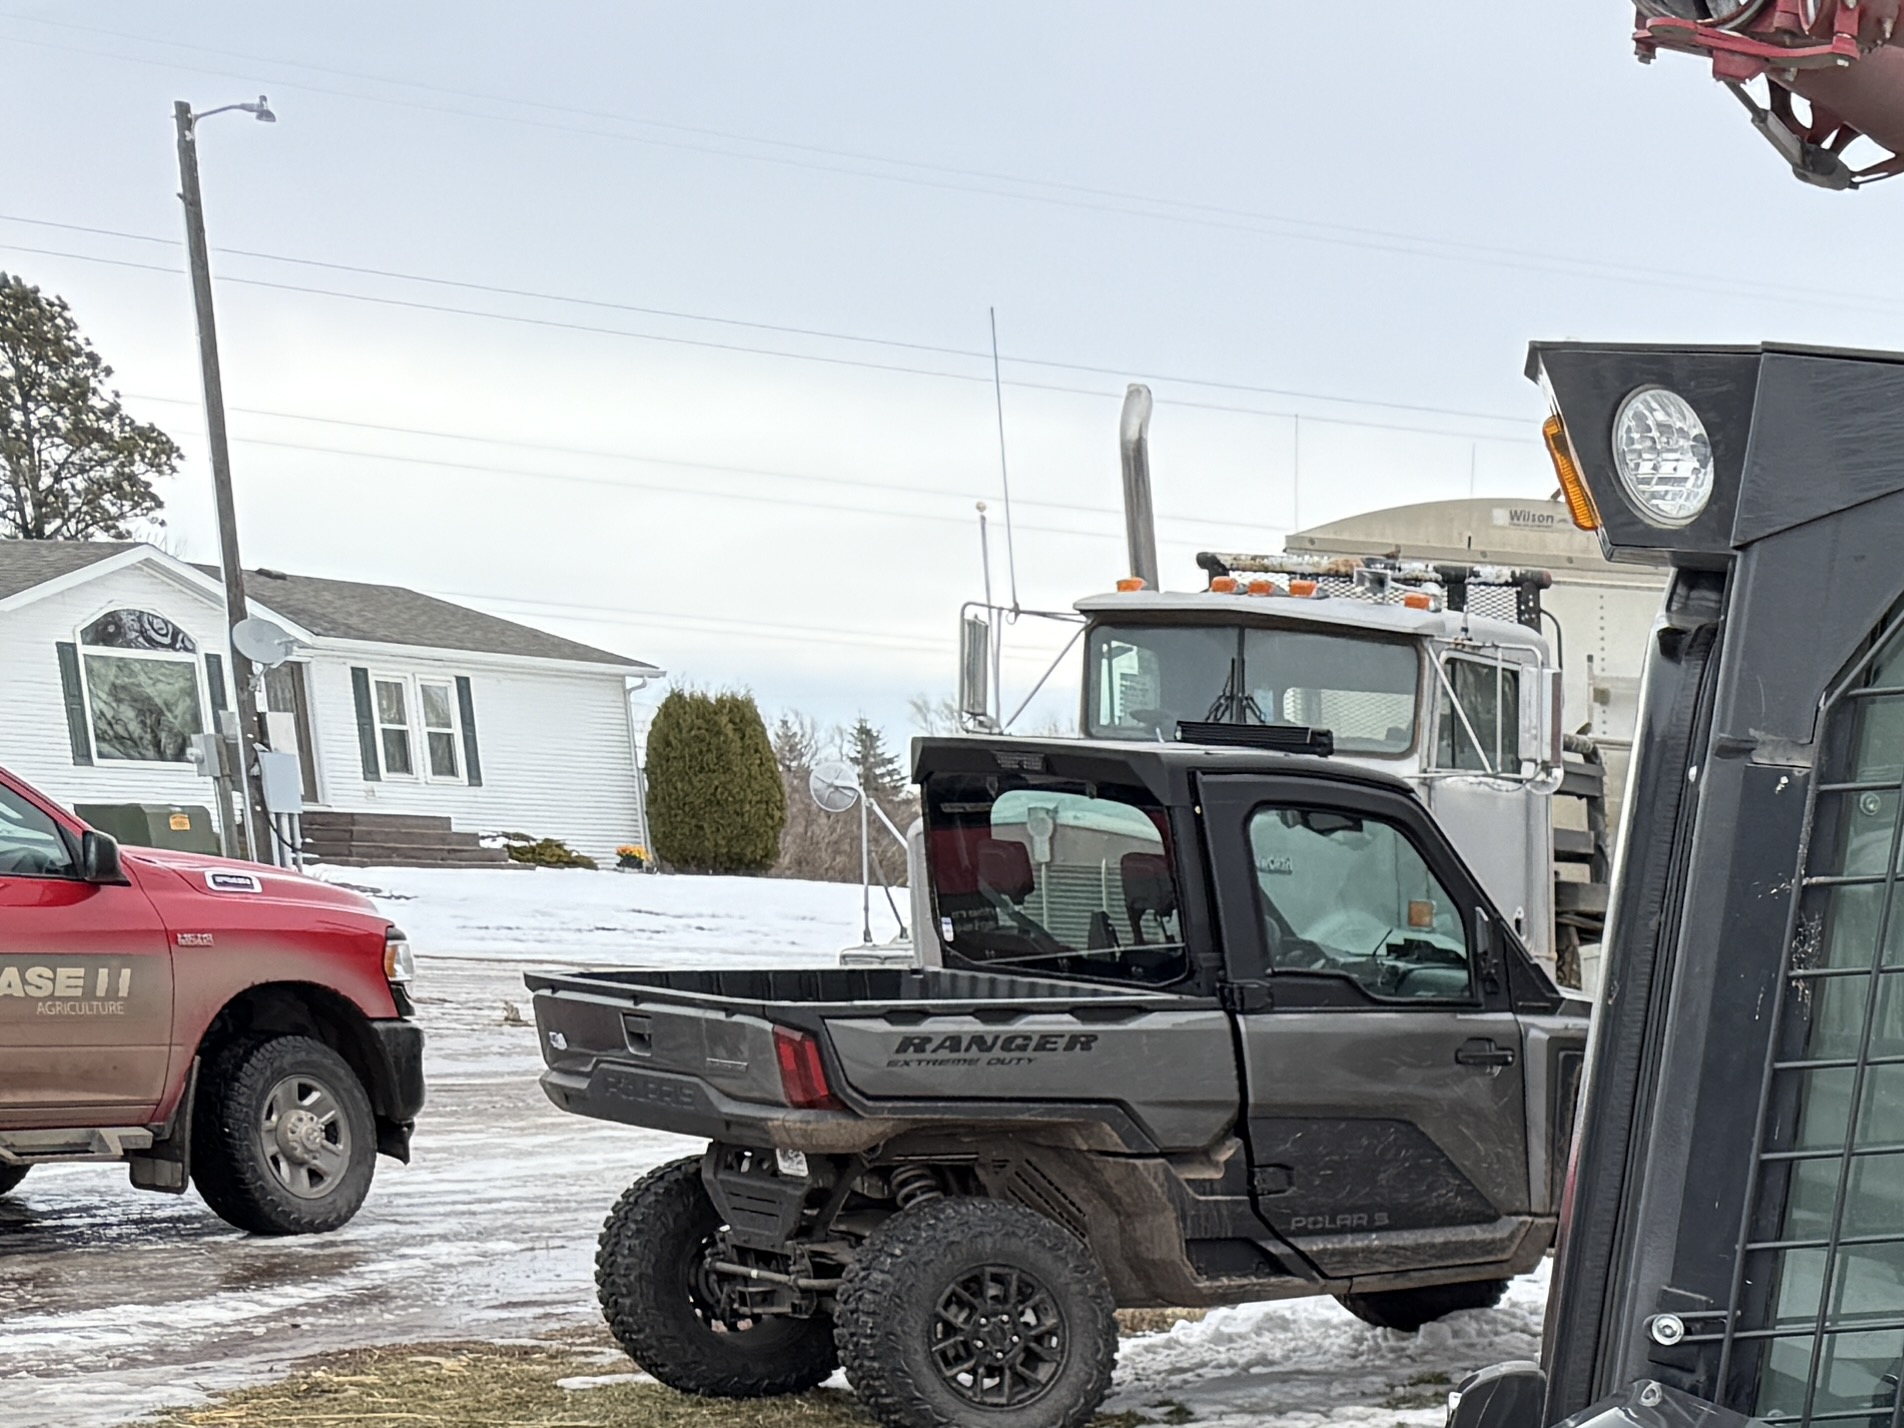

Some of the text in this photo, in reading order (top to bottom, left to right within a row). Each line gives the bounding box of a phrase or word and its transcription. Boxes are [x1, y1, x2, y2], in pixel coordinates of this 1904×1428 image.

[1509, 509, 1554, 524] Wilson
[0, 966, 85, 998] ASE
[36, 1001, 125, 1015] AGRICULTURE
[895, 1034, 1099, 1054] RANGER
[886, 1057, 1038, 1068] EXTREME DUTY
[1290, 1211, 1390, 1231] POLARS
